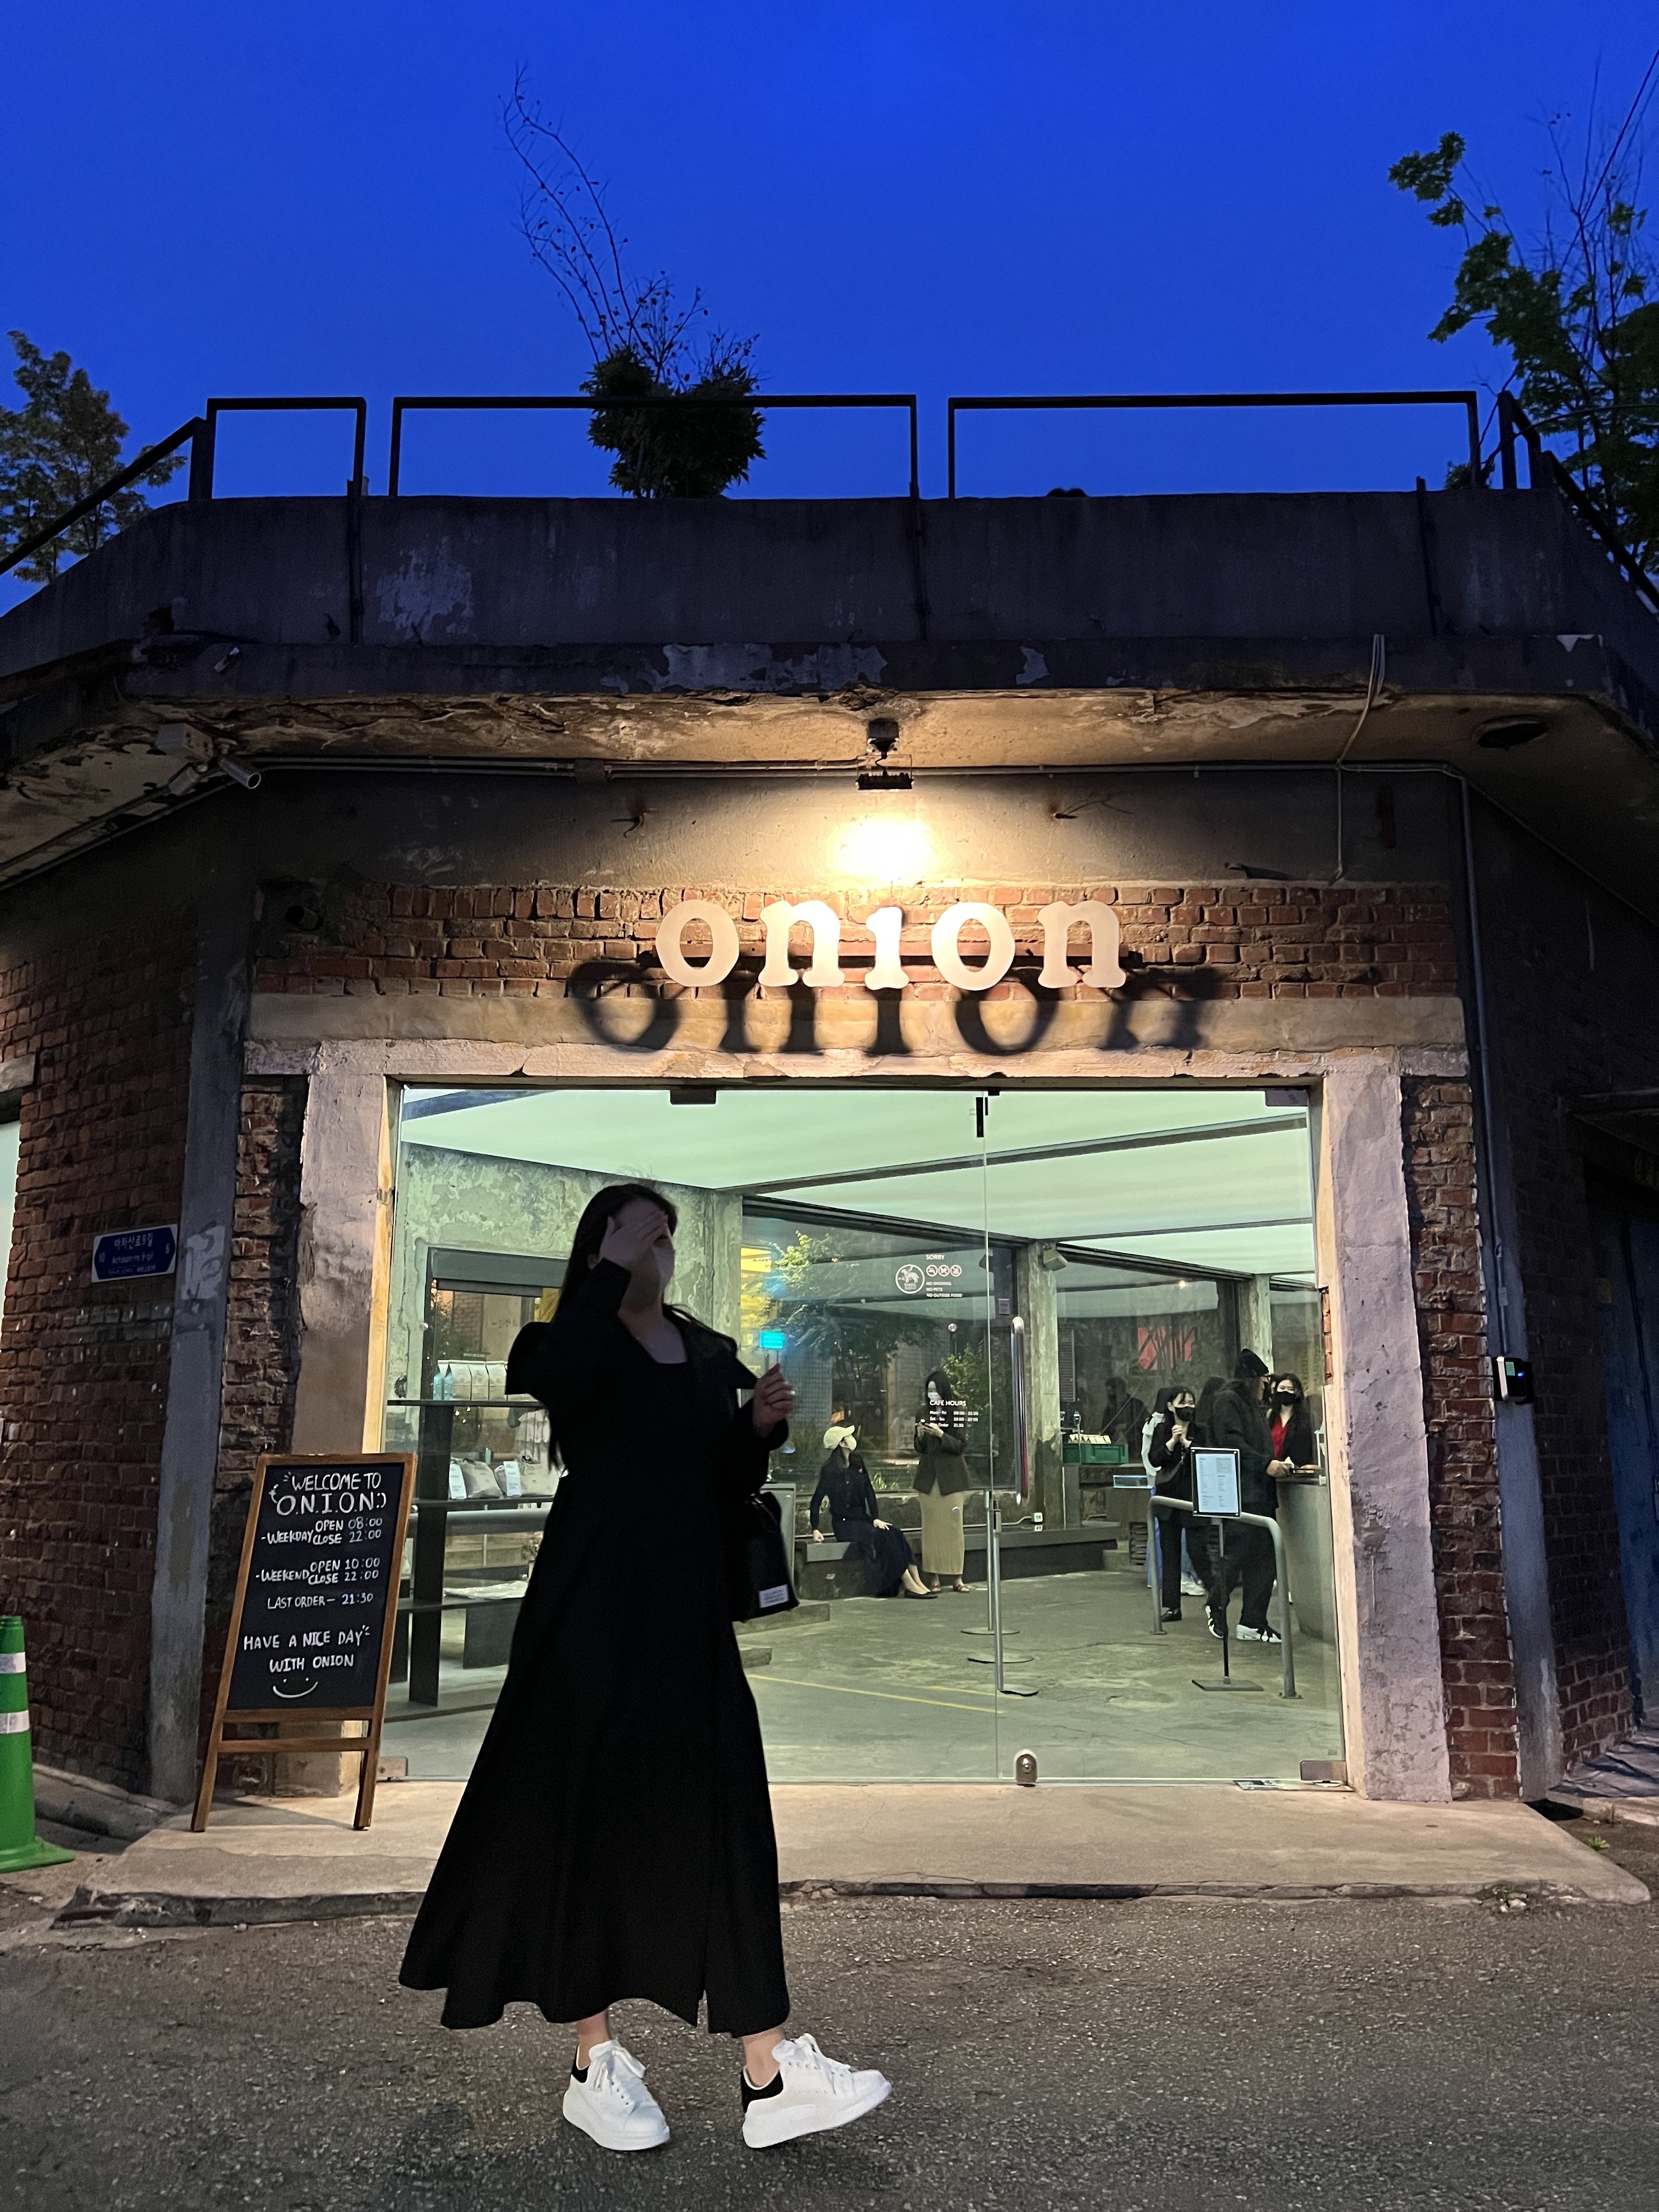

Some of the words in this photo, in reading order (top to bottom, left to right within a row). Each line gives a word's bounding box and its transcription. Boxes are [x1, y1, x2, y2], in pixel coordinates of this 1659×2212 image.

[657, 899, 1126, 990] onion
[292, 1473, 361, 1491] WELCOME
[363, 1472, 382, 1489] TO
[315, 1520, 344, 1532] OPEN
[348, 1516, 383, 1530] 08:00
[313, 1533, 342, 1545] CLOSE
[349, 1530, 382, 1543] 22:00
[310, 1559, 340, 1573] OPEN
[345, 1558, 380, 1570] 10:00
[308, 1573, 338, 1585] CLOSE
[344, 1570, 379, 1581] 22:00
[267, 1596, 292, 1609] LAST
[295, 1595, 325, 1608] ORDER
[342, 1593, 374, 1605] 21:30
[244, 1635, 280, 1650] HAVE
[289, 1635, 297, 1647] A
[303, 1630, 330, 1647] NICE
[338, 1629, 363, 1646] DAY
[269, 1657, 305, 1673] WITH
[312, 1654, 354, 1669] ONION
